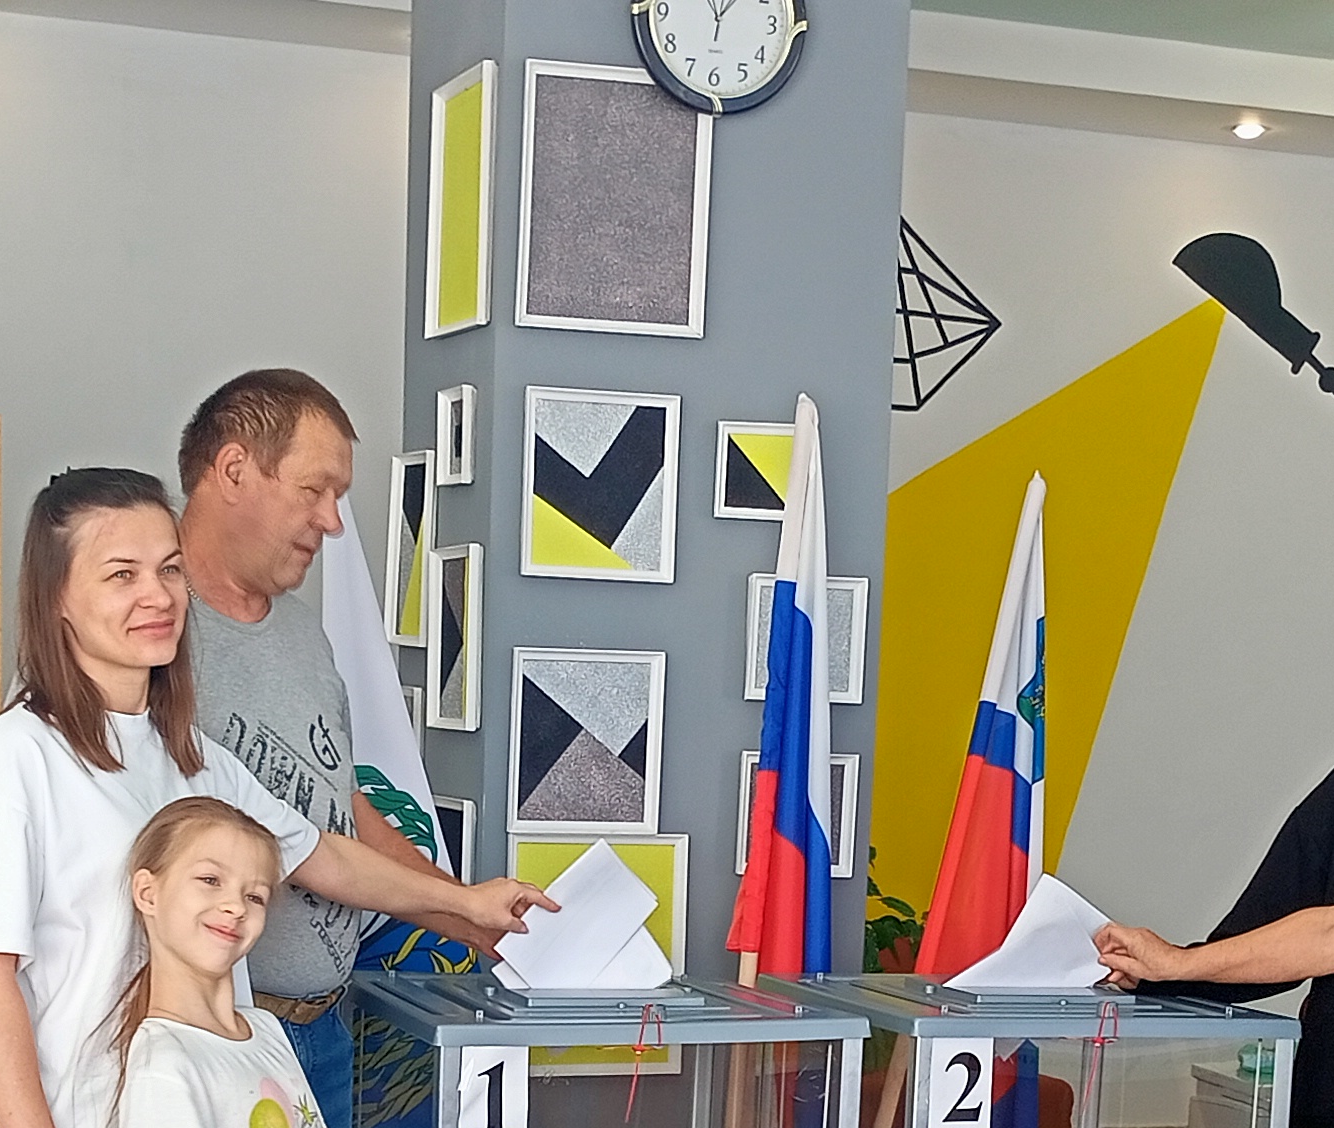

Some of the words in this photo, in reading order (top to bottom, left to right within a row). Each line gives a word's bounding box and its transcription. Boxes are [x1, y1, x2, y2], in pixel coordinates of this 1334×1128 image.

[657, 2, 669, 22] 9
[767, 15, 777, 35] 3
[664, 33, 676, 53] 8
[754, 45, 765, 64] 4
[685, 58, 696, 77] 7
[708, 67, 720, 86] 6
[737, 63, 748, 82] 5
[942, 1051, 984, 1123] 2
